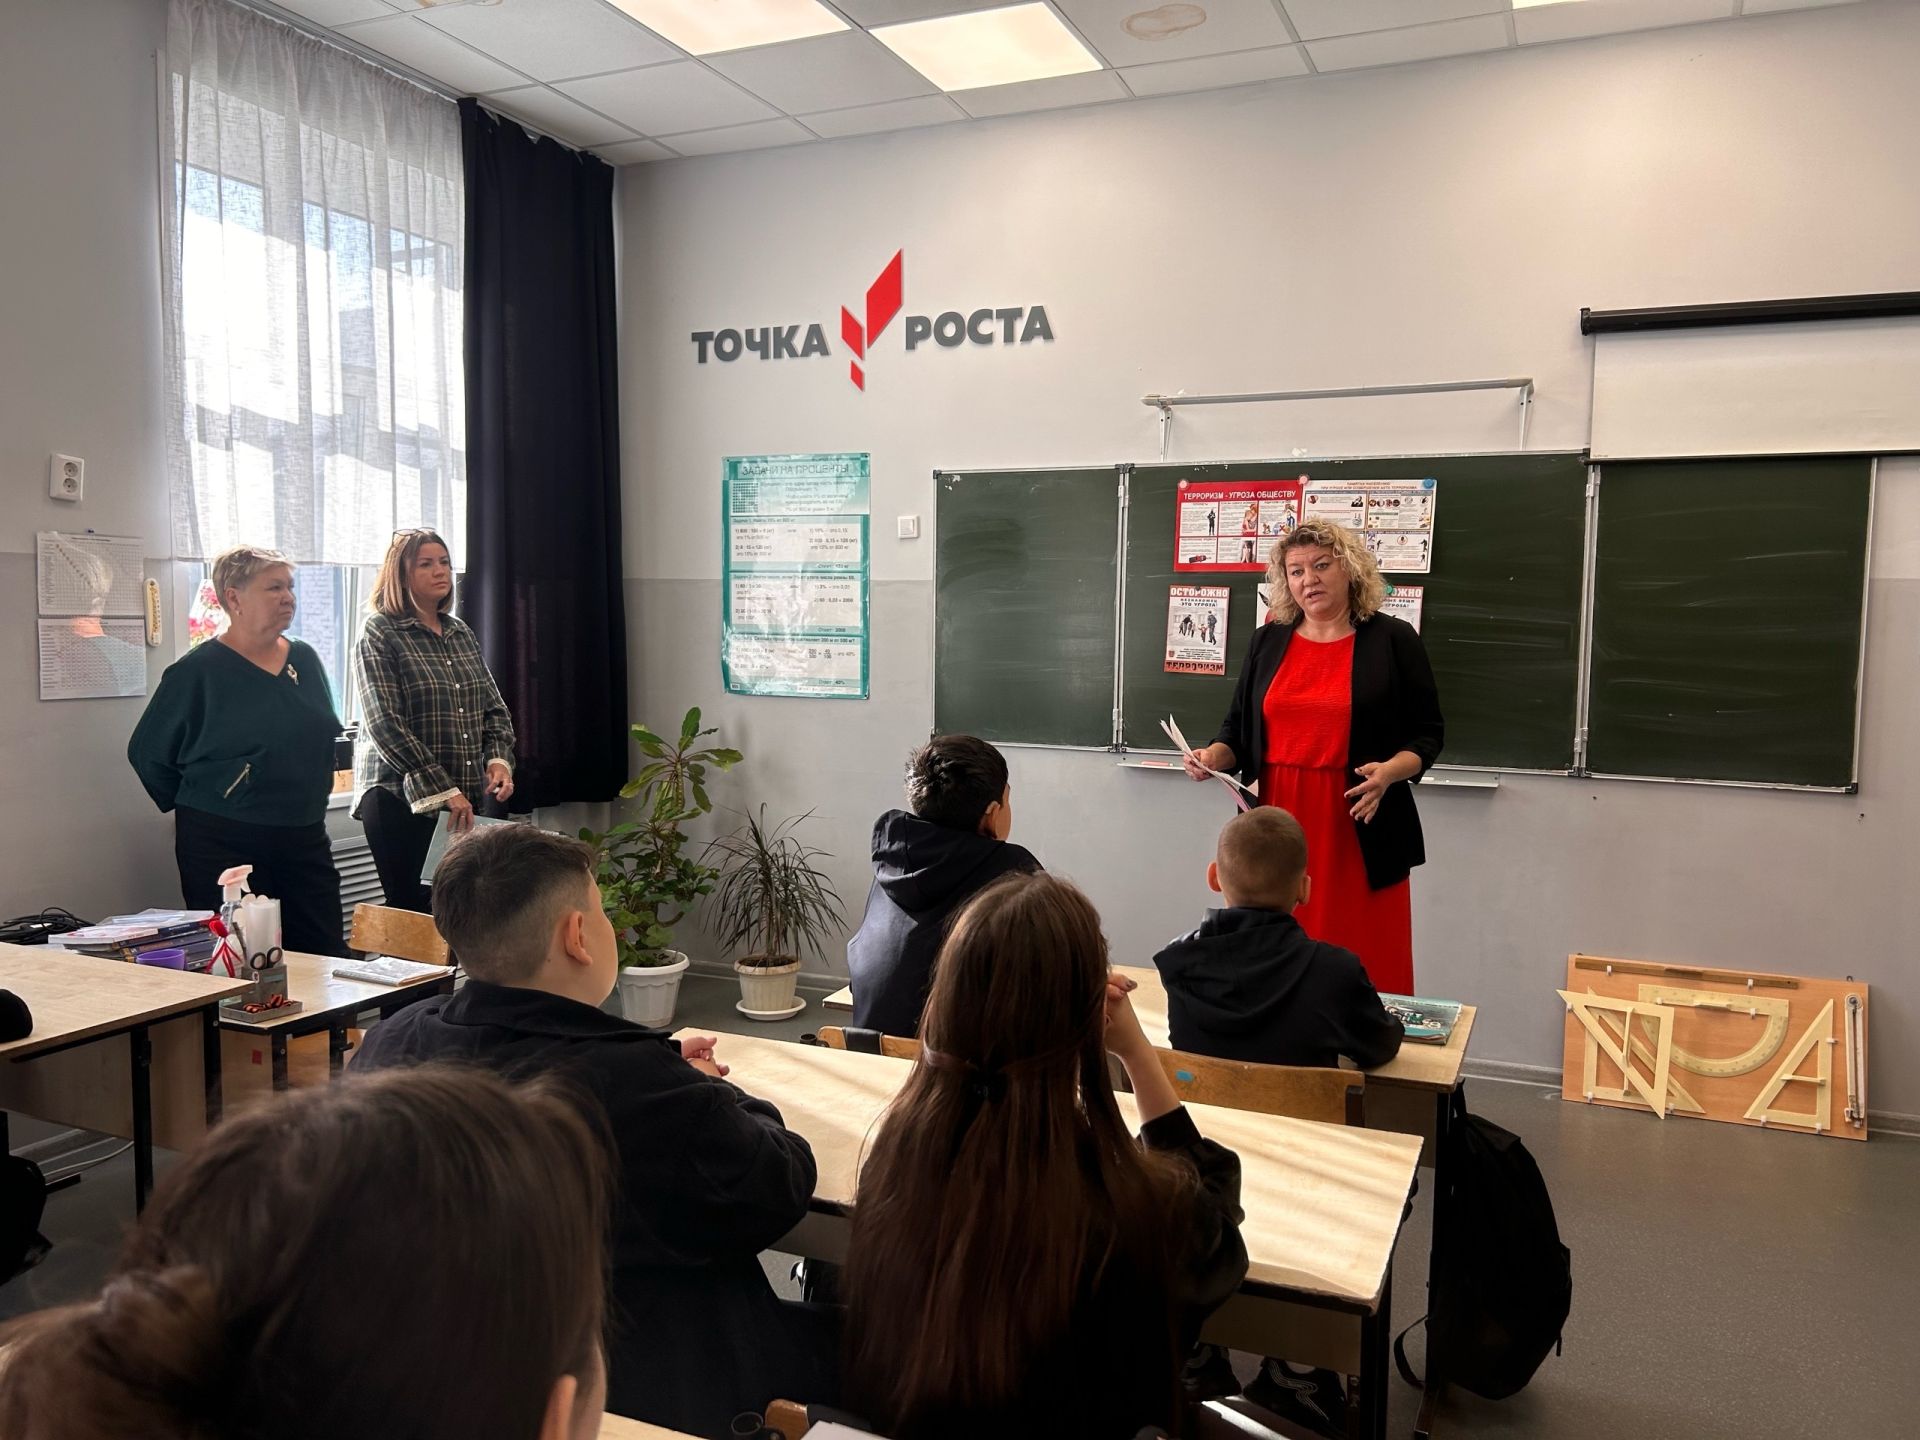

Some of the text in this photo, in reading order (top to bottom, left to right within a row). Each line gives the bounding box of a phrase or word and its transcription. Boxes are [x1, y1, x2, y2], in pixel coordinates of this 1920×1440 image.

[691, 305, 1054, 364] ТОЧКА РОСТА
[742, 463, 849, 476] ЗАДАЧИ НА ПРОЦЕНТЫ
[1183, 492, 1223, 500] ТЕРРОРИЗМ
[1228, 491, 1255, 499] УГРОЗА
[1256, 490, 1296, 499] ОБЩЕСТВУ
[1170, 587, 1228, 598] ОСТОРОЖНО
[1166, 661, 1223, 672] ТЕРРОРИЗМ
